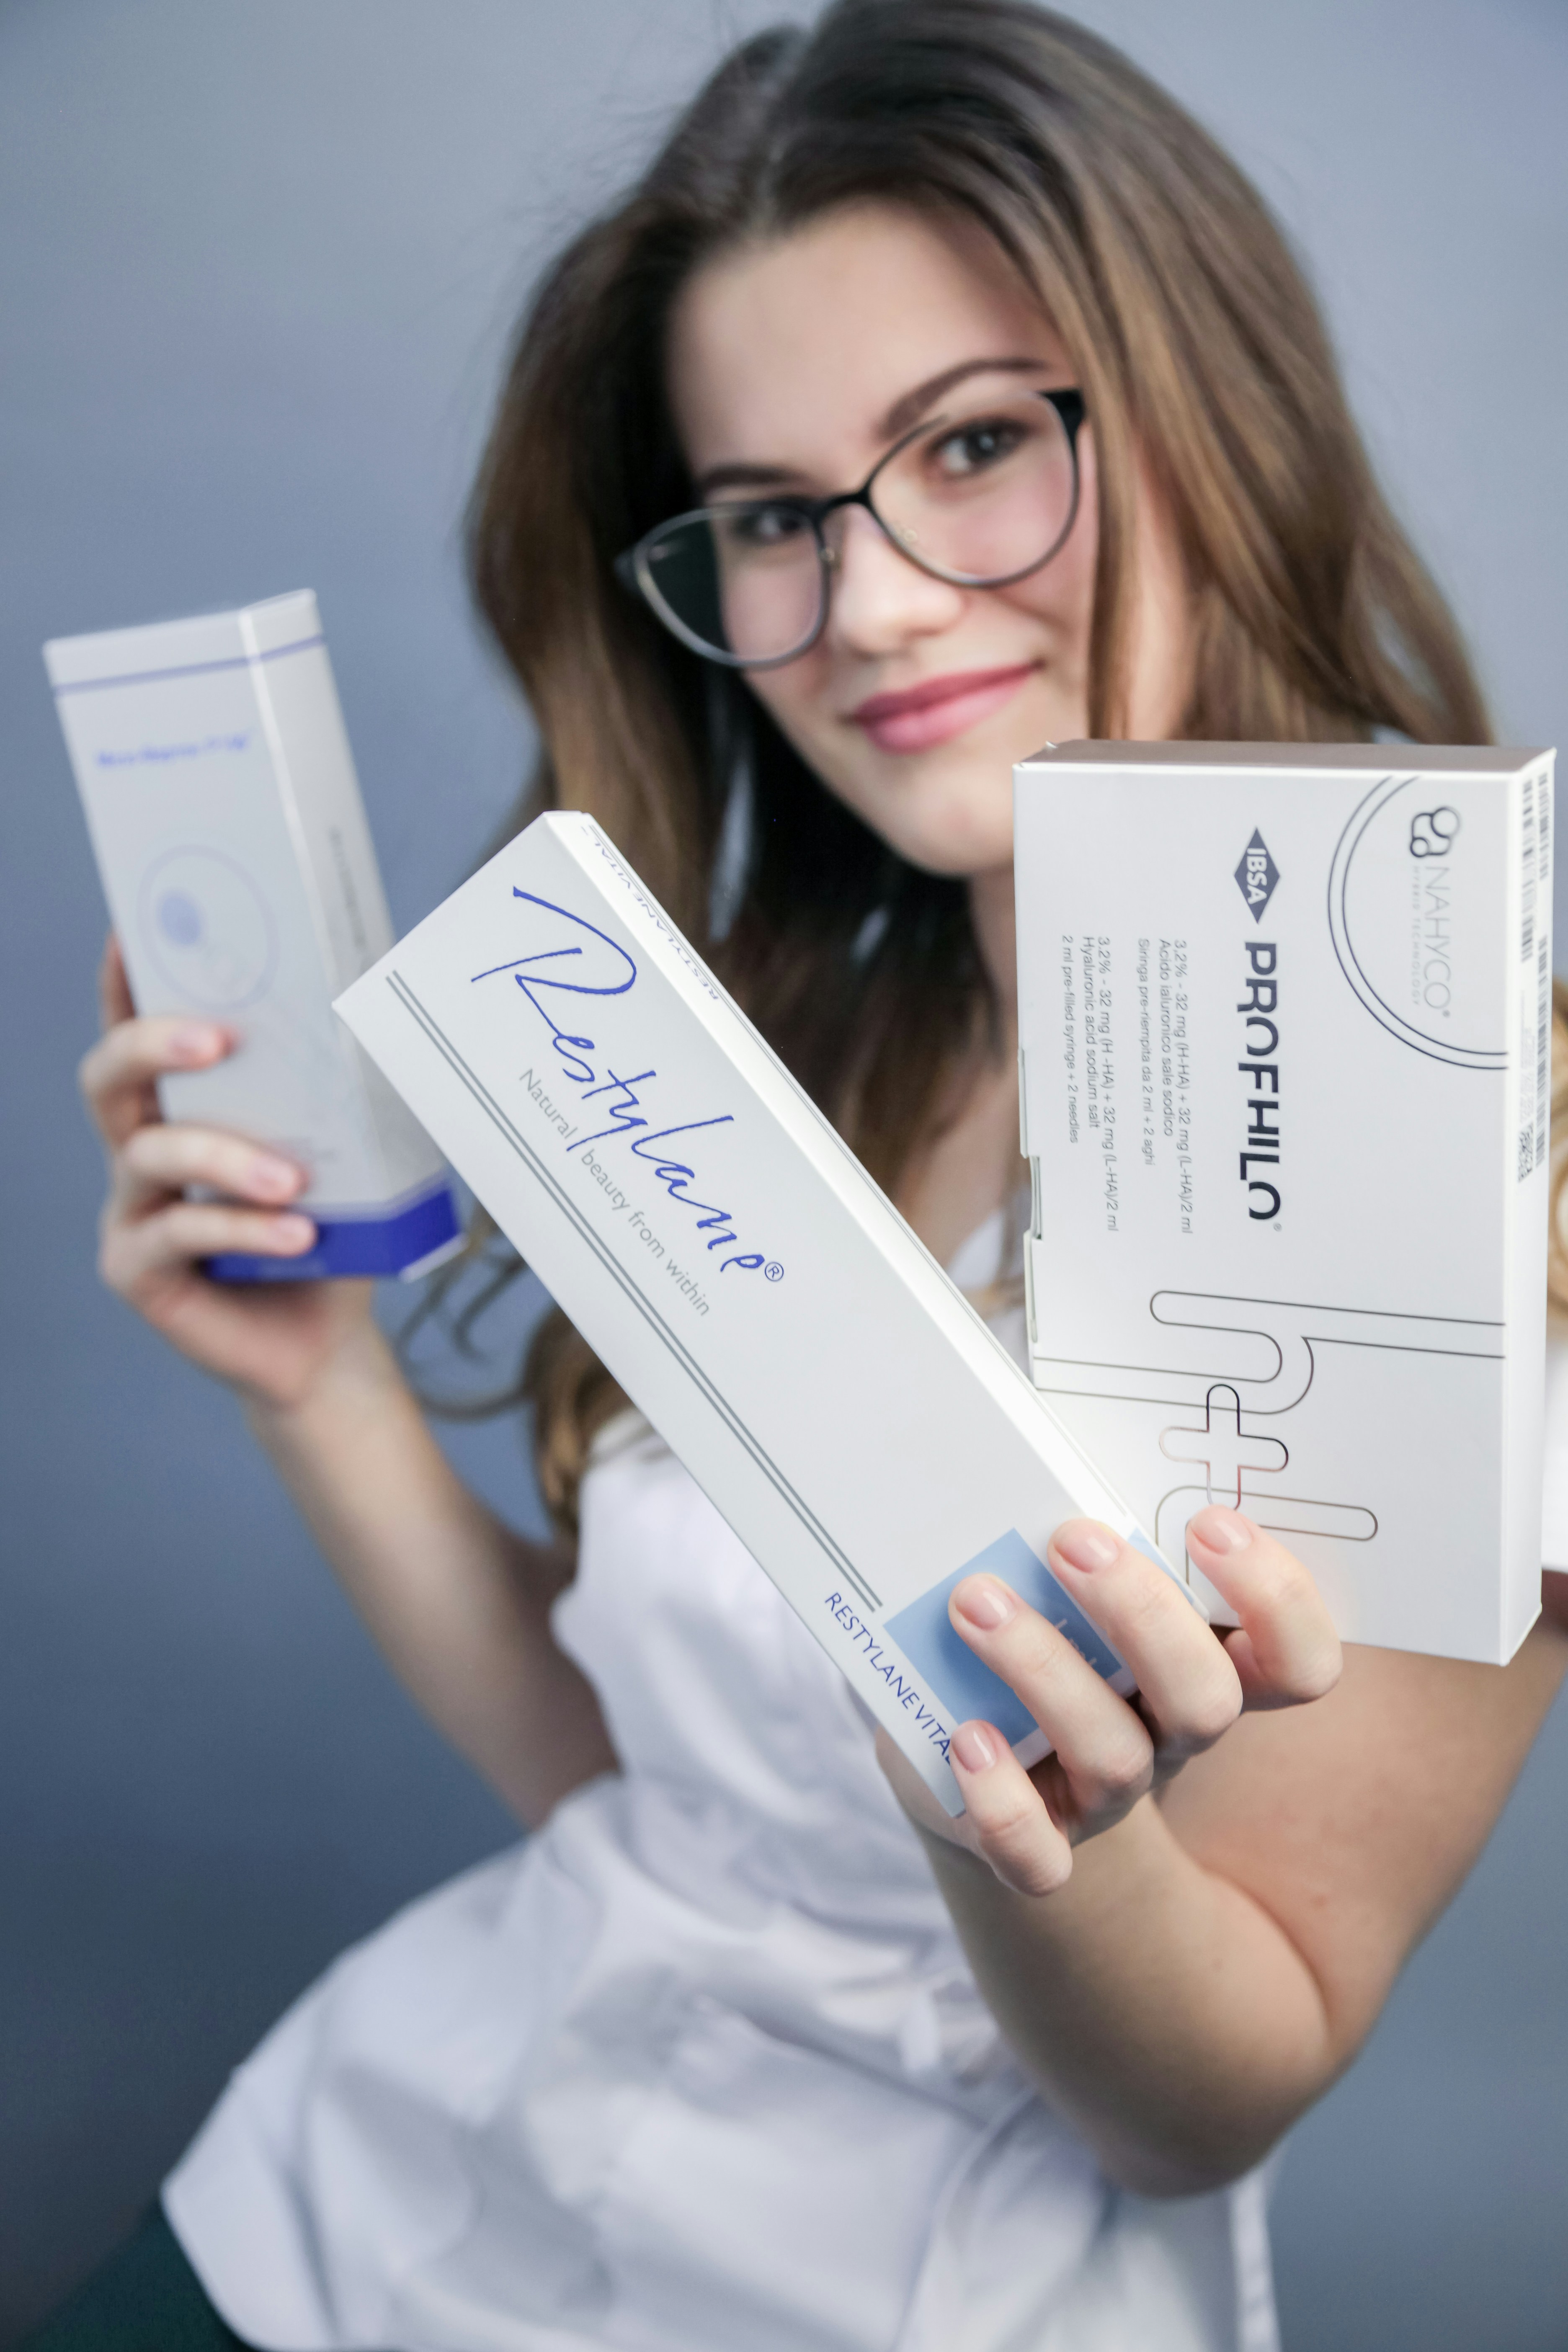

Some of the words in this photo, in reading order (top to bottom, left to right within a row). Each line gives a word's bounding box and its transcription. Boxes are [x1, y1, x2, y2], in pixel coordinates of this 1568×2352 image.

[1246, 848, 1268, 905] IBSA
[1063, 947, 1074, 962] ml
[1136, 939, 1150, 982] Siringa
[1158, 939, 1172, 981] Acido
[1080, 936, 1097, 1011] Hyaluronic
[1061, 966, 1076, 1021] pre-filled
[1099, 989, 1112, 1007] 32
[1175, 993, 1189, 1011] 32
[1084, 1015, 1099, 1045] acid
[1098, 1011, 1110, 1034] mg
[1137, 985, 1152, 1062] pre-riempita
[1160, 985, 1173, 1053] ialuronico
[1173, 1015, 1186, 1038] mg
[1063, 1025, 1077, 1069] syringe
[1086, 1049, 1099, 1100] sodium
[1141, 1066, 1153, 1082] da
[1161, 1057, 1175, 1086] sale
[1175, 1042, 1190, 1089] (H-HA)
[1142, 1085, 1153, 1093] 2
[1088, 1104, 1101, 1128] salt
[1103, 1106, 1116, 1124] 32
[1143, 1097, 1154, 1112] ml
[1162, 1090, 1176, 1137] sodico
[1178, 1107, 1191, 1125] 32
[1068, 1096, 1080, 1143] needles
[1143, 1127, 1155, 1135] 2
[1101, 1128, 1114, 1150] mg
[1141, 1139, 1155, 1165] aghi
[1176, 1129, 1189, 1151] mg
[519, 1068, 578, 1139] Natural
[581, 1149, 630, 1212] beauty
[628, 1211, 665, 1259] from
[666, 1259, 710, 1316] within
[1107, 1215, 1119, 1231] ml
[1181, 1217, 1194, 1233] ml
[825, 1592, 920, 1709] RESTYLANE
